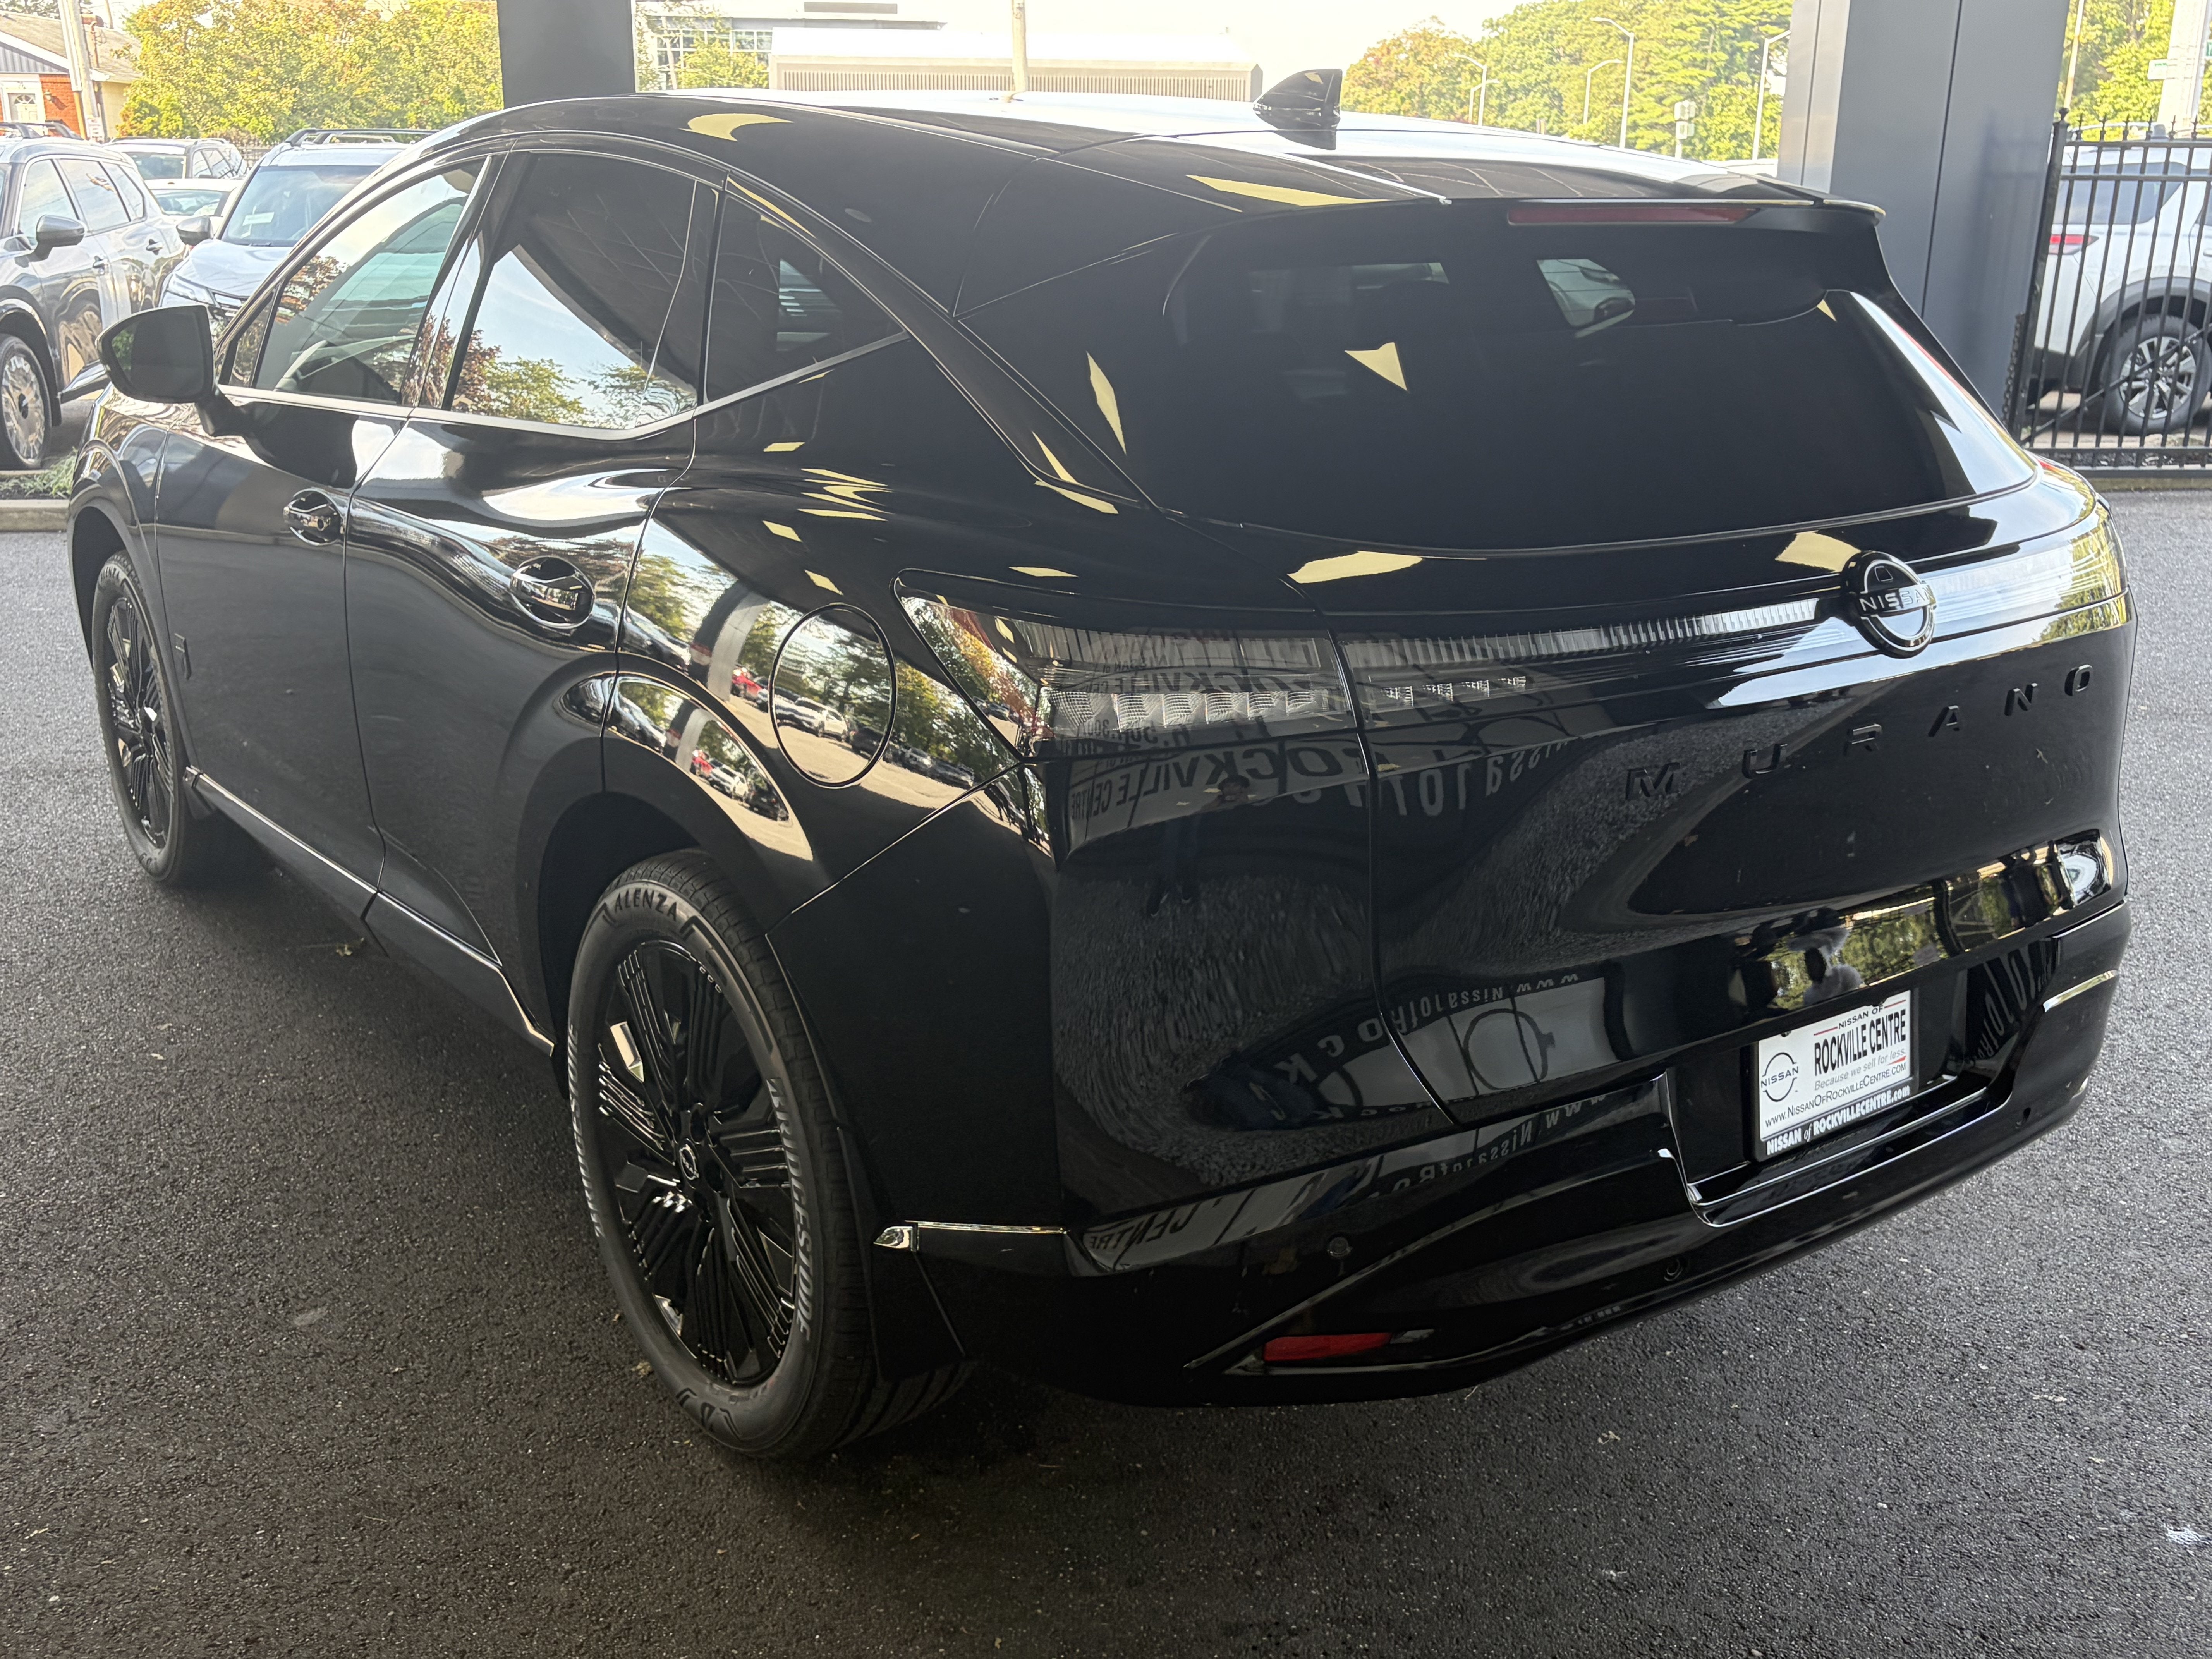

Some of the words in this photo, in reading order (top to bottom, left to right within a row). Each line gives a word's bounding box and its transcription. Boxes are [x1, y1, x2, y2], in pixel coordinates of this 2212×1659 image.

[1859, 584, 1936, 612] NISSAN
[1625, 664, 2094, 800] MURANO
[614, 888, 678, 922] ALENZA
[1838, 1011, 1869, 1029] NISSAN
[1872, 1005, 1884, 1015] OF
[1814, 1025, 1868, 1076] ROCKVILLE
[1869, 1009, 1906, 1052] CENTRE
[1761, 1066, 1798, 1088] NISSAN
[1814, 1073, 1848, 1091] Because
[1850, 1066, 1861, 1076] we
[1863, 1059, 1876, 1071] sell
[1877, 1054, 1888, 1065] for
[1889, 1048, 1906, 1060] less.
[1767, 1128, 1802, 1155] NISSAN
[1804, 1125, 1813, 1141] of
[1813, 1086, 1910, 1135] ROCKVILLECENTRE.com
